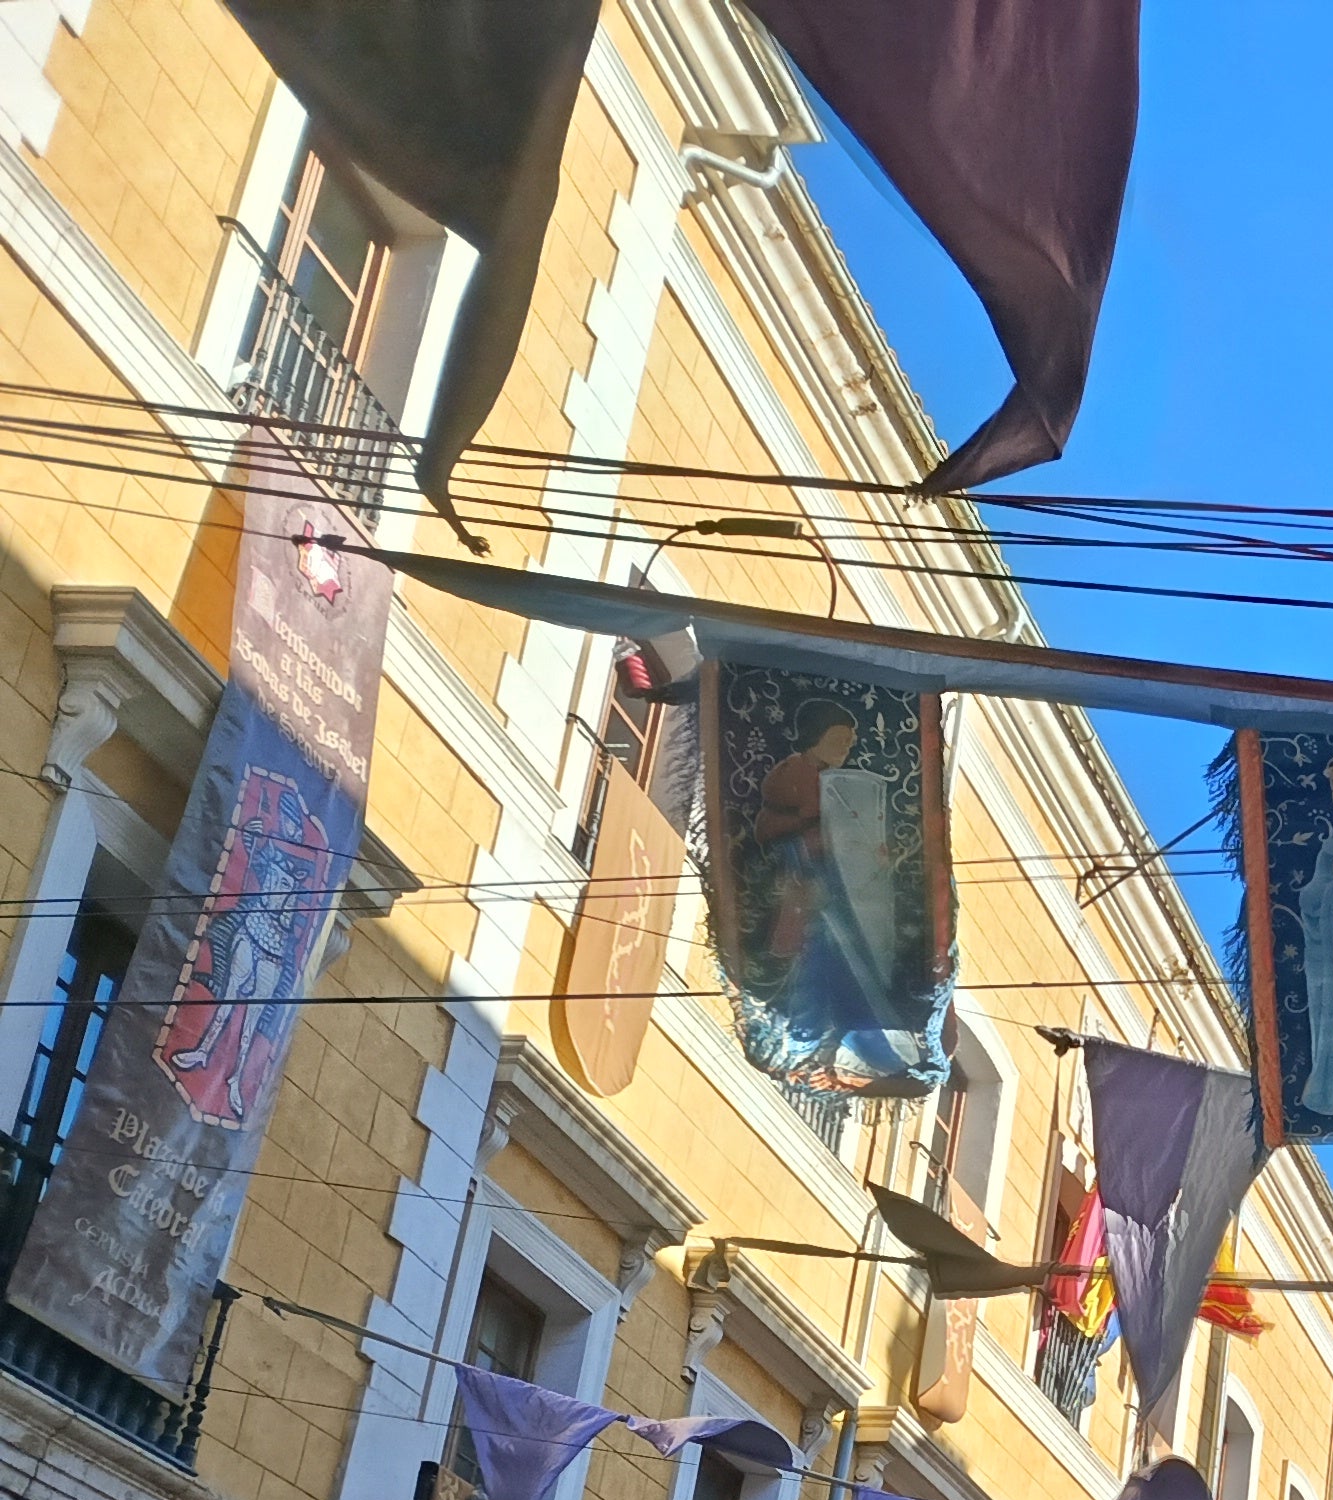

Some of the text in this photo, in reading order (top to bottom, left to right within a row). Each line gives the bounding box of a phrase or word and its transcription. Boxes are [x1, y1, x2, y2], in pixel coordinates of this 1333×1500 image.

[235, 626, 367, 783] Bodas de Isabel
[280, 653, 325, 705] a las
[109, 1107, 177, 1179] Plaza
[108, 1163, 206, 1253] Catedral
